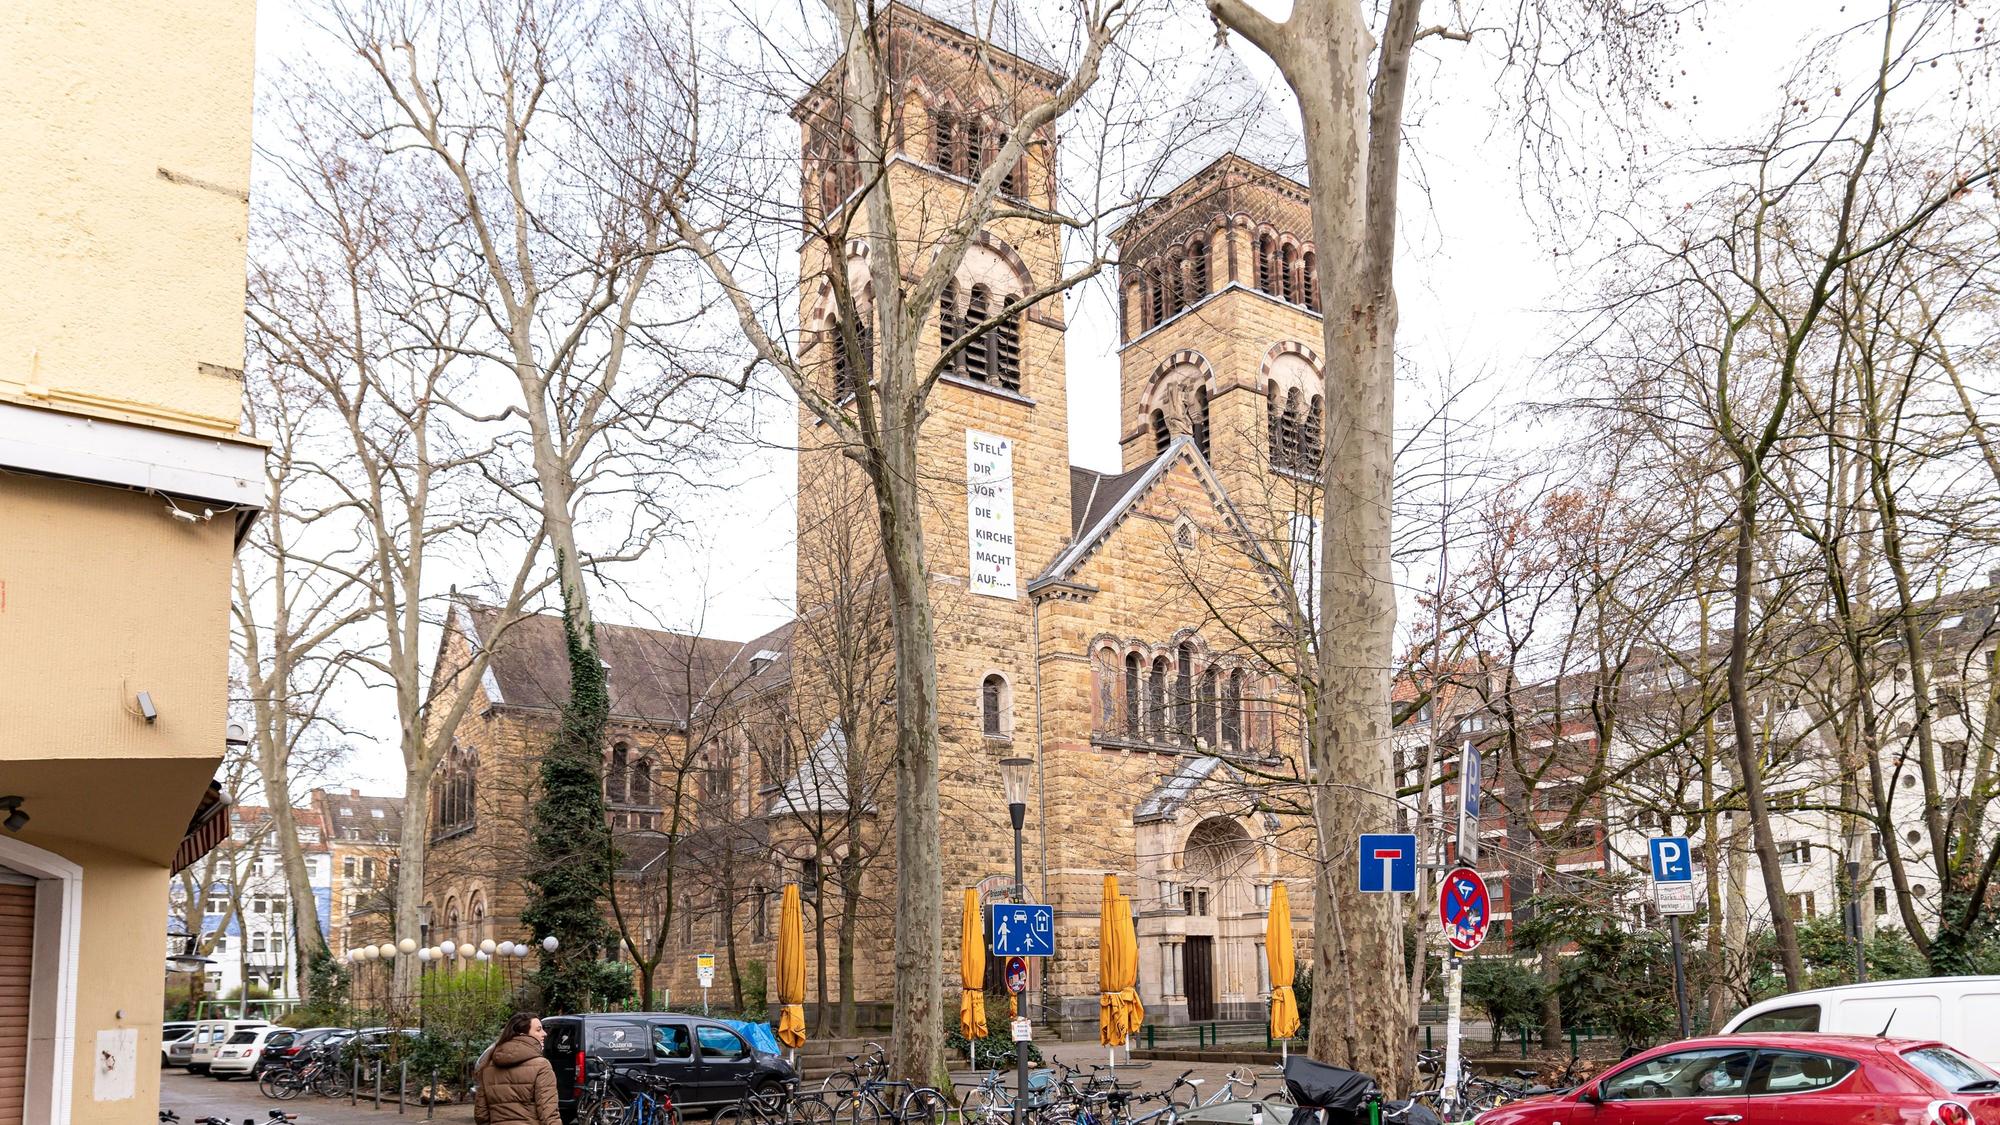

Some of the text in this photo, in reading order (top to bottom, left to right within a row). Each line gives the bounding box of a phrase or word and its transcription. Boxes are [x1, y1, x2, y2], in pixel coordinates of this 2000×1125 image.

[973, 441, 1003, 457] STELL
[974, 463, 991, 476] DIR
[974, 485, 995, 498] VOR
[975, 506, 992, 519] DIE
[976, 529, 1013, 545] KIRCHE
[976, 551, 1012, 566] MACHT
[1659, 842, 1681, 875] P
